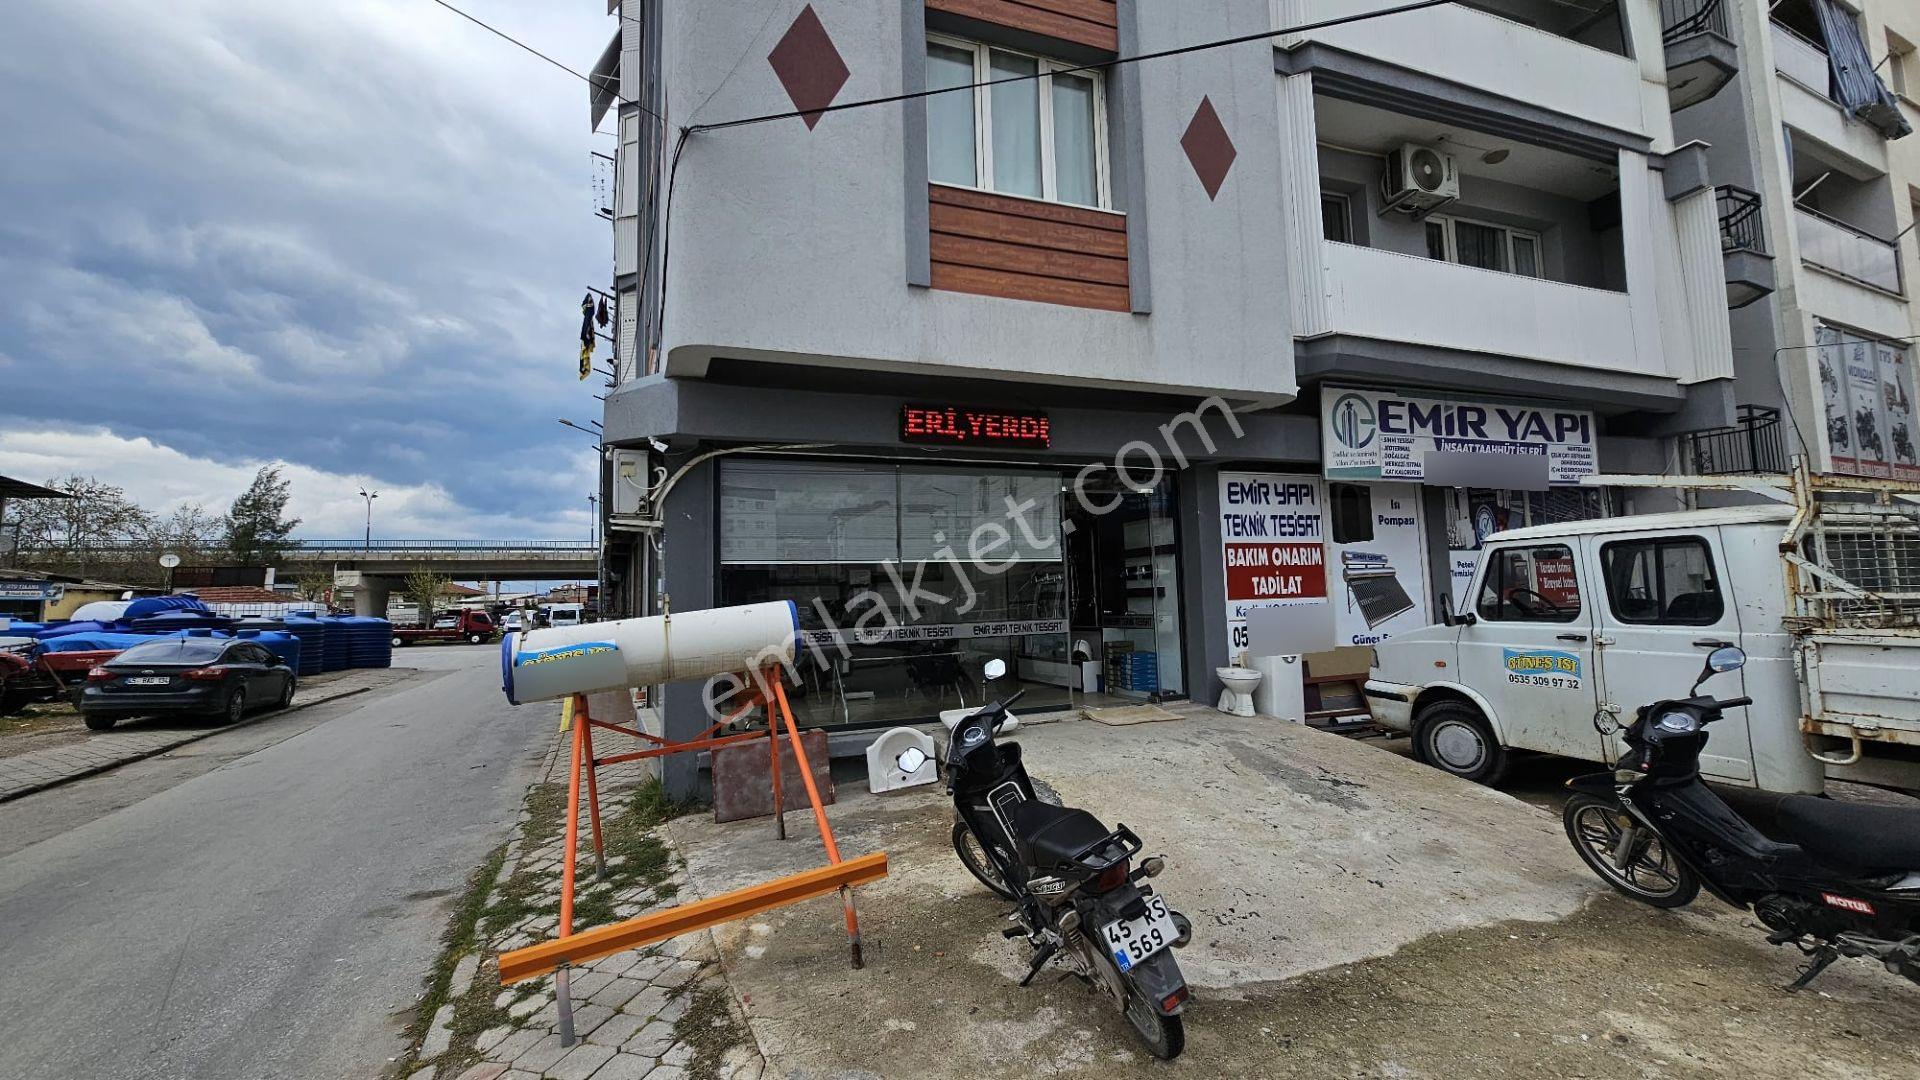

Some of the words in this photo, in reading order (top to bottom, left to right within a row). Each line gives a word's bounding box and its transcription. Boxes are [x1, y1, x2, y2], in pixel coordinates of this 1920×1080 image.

[1495, 409, 1591, 444] YAPI
[1274, 482, 1315, 506] YAPI
[1224, 511, 1270, 537] TEKNİK
[1378, 515, 1415, 527] Pompası
[1227, 548, 1269, 567] BAKIM
[1271, 547, 1323, 566] ONARIM
[1252, 571, 1303, 596] TADİLAT
[1508, 674, 1530, 685] 0535
[1532, 676, 1550, 686] 309
[1552, 678, 1564, 687] 97
[1567, 680, 1579, 689] 32
[1826, 894, 1872, 913] MOTUL
[1108, 920, 1132, 944] 45
[1144, 900, 1166, 926] RS
[1128, 928, 1164, 960] 569
[1121, 962, 1130, 970] TR
